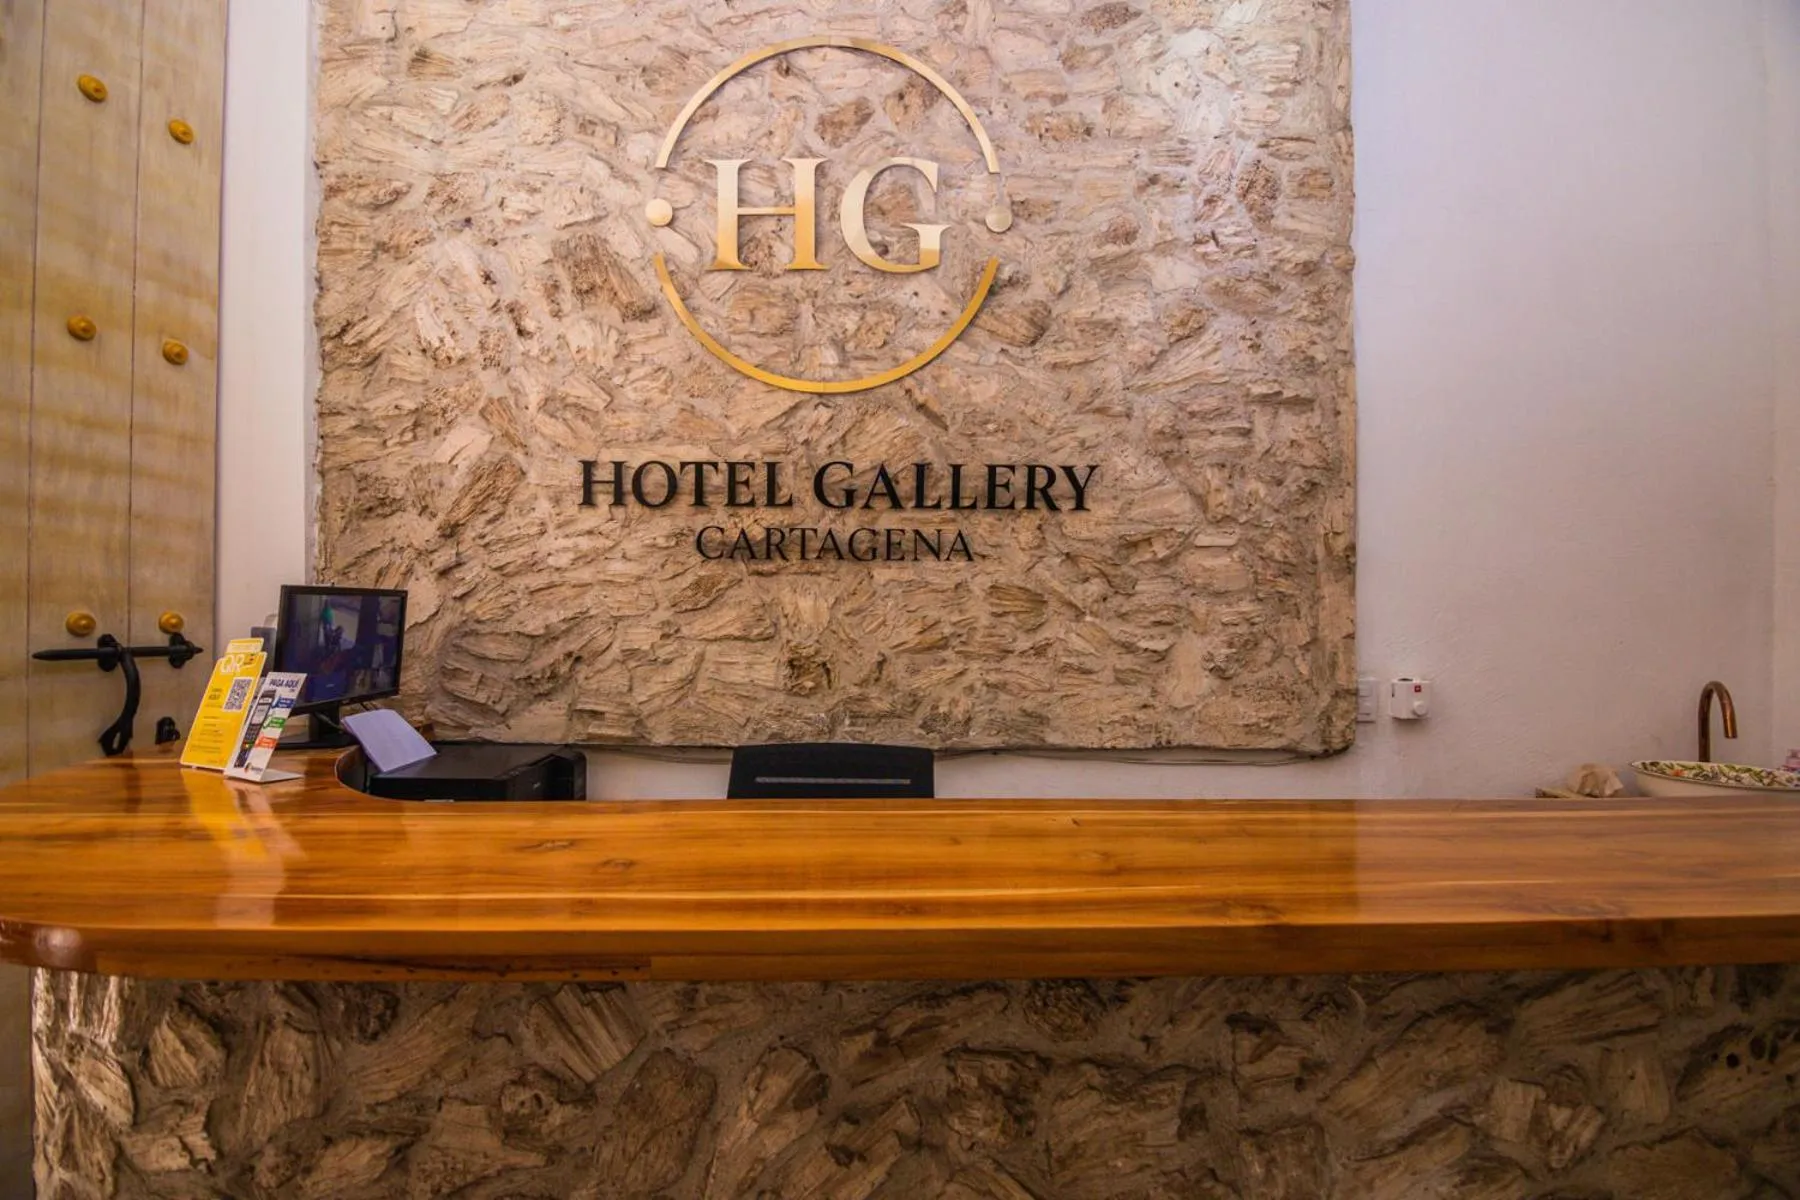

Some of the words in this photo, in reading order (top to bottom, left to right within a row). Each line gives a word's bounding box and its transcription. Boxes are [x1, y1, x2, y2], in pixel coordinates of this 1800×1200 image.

[704, 157, 951, 272] HG
[579, 460, 793, 508] HOTEL
[813, 461, 1098, 511] GALLERY
[696, 525, 975, 562] CARTAGENA
